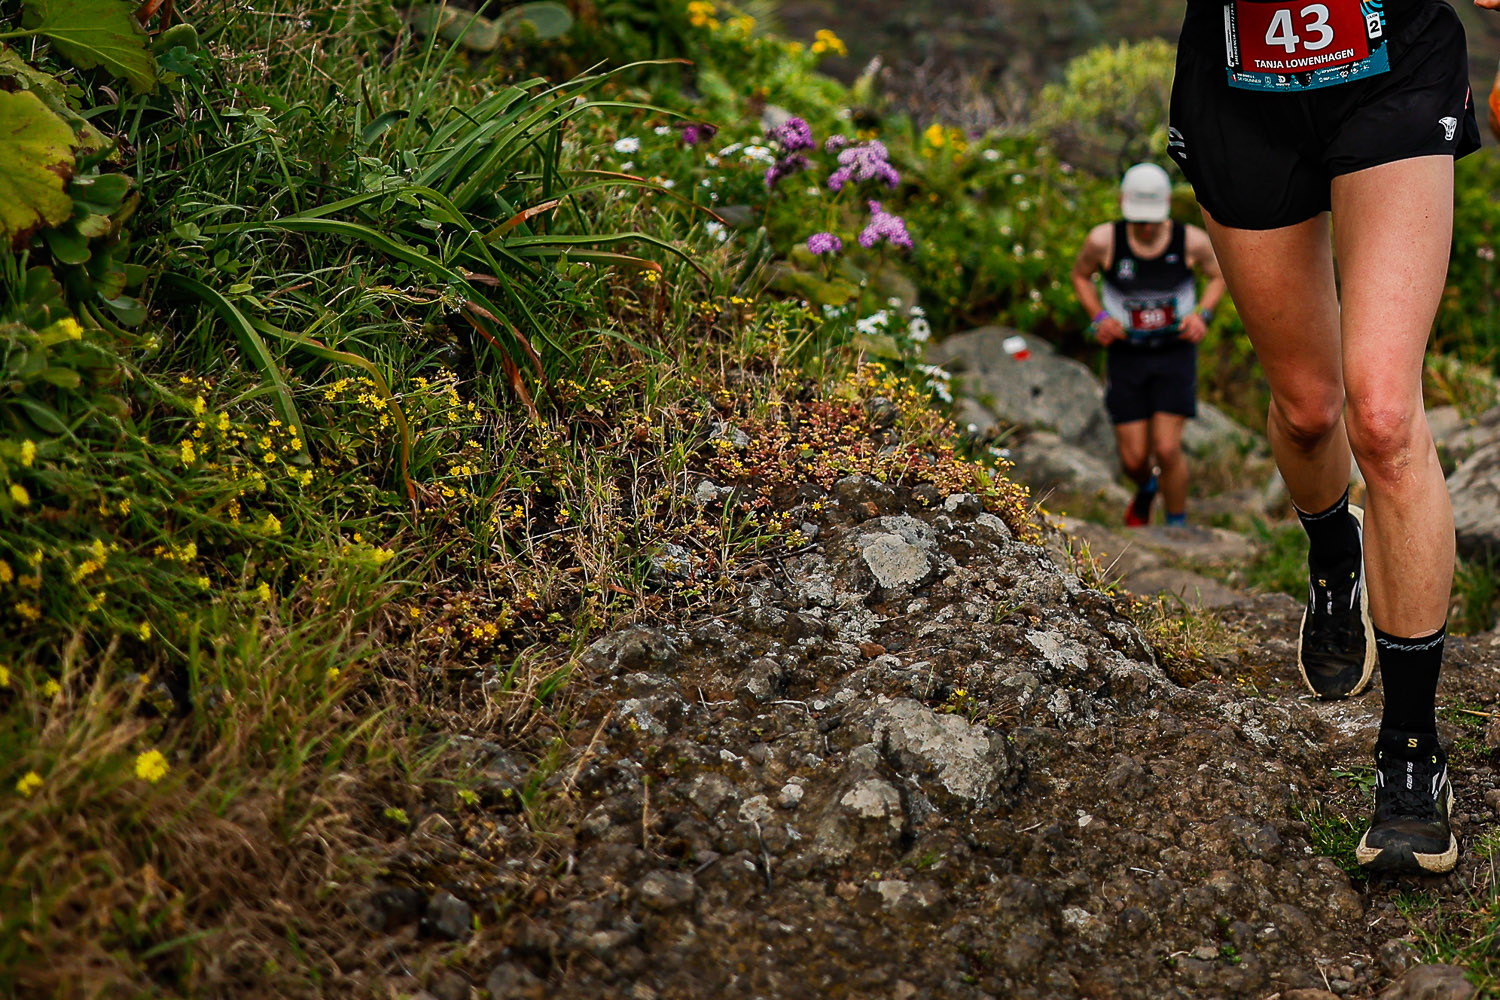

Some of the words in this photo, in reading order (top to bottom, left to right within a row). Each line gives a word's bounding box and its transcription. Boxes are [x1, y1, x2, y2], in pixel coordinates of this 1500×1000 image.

[1265, 3, 1335, 54] 43
[1369, 20, 1381, 34] 2
[1254, 59, 1284, 69] TANJA
[1285, 48, 1355, 68] LOWENHAGEN
